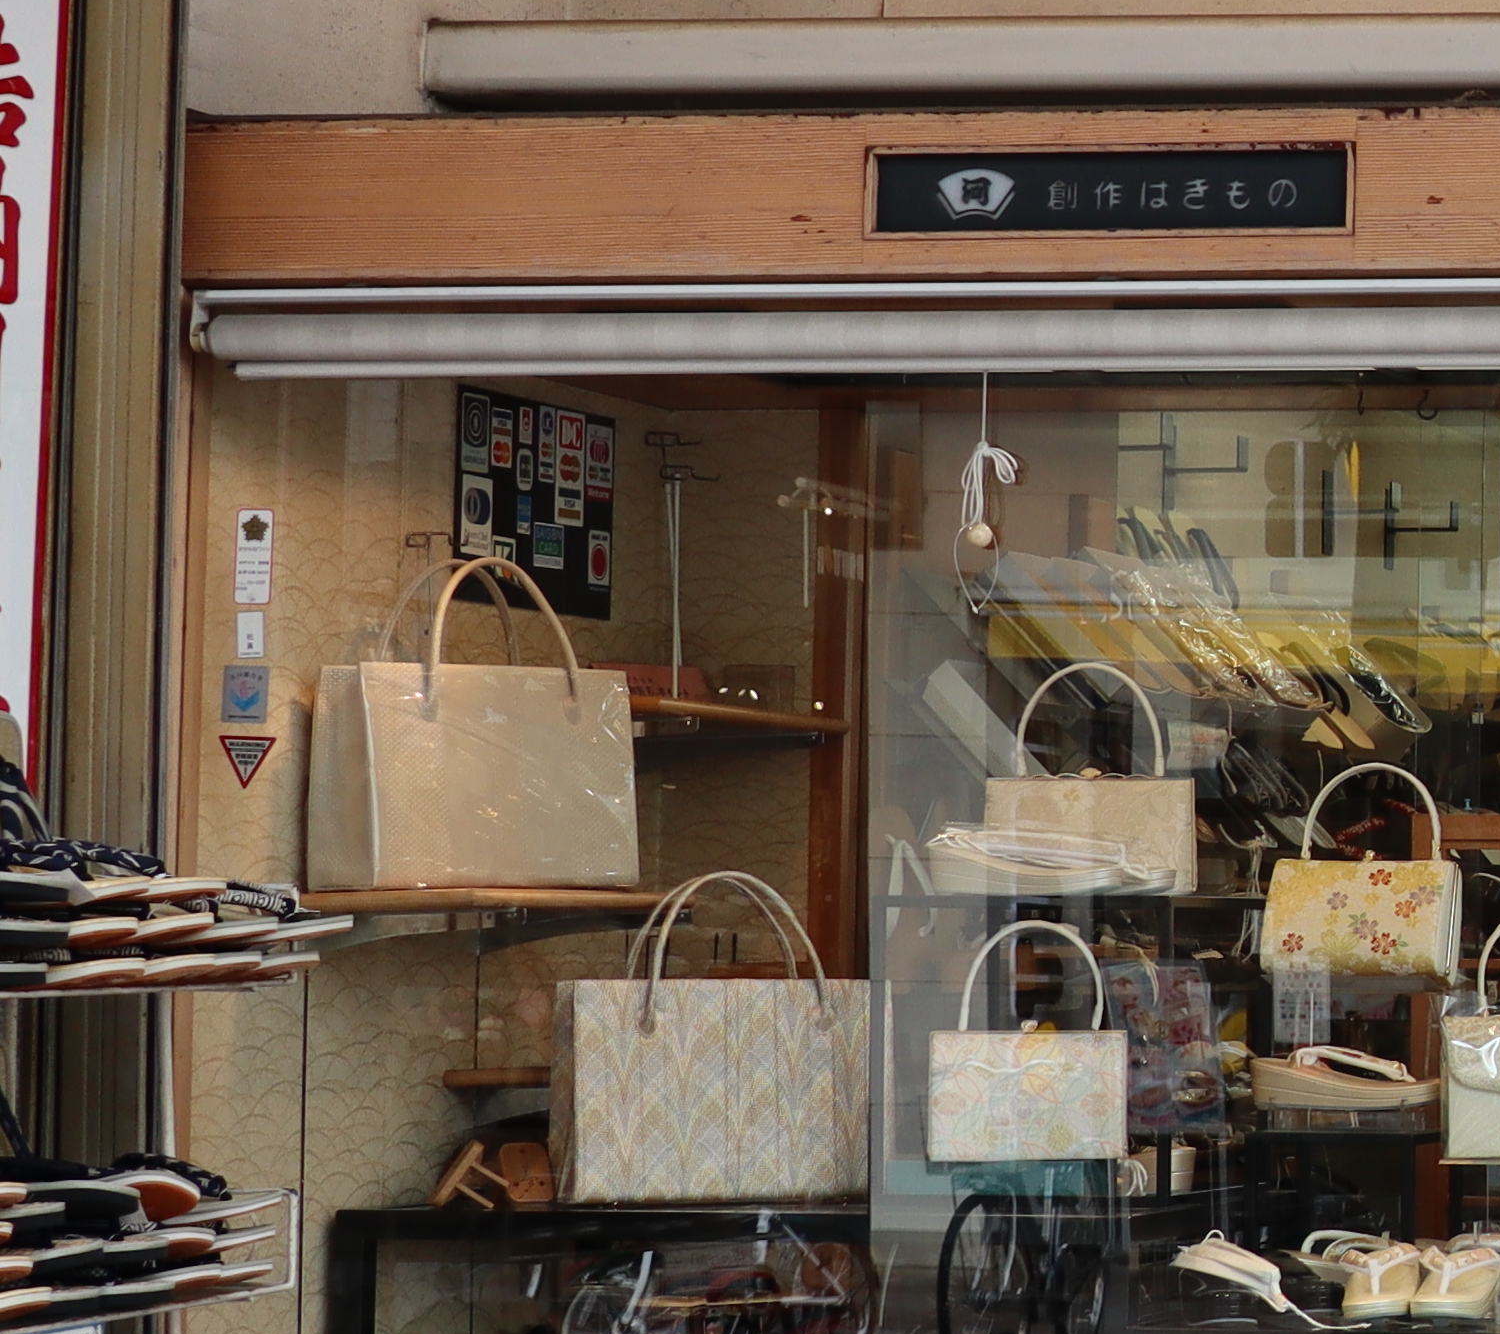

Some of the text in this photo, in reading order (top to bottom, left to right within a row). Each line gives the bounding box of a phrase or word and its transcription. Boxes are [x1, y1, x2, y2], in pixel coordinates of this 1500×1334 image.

[1046, 178, 1299, 211] 創作はきもの
